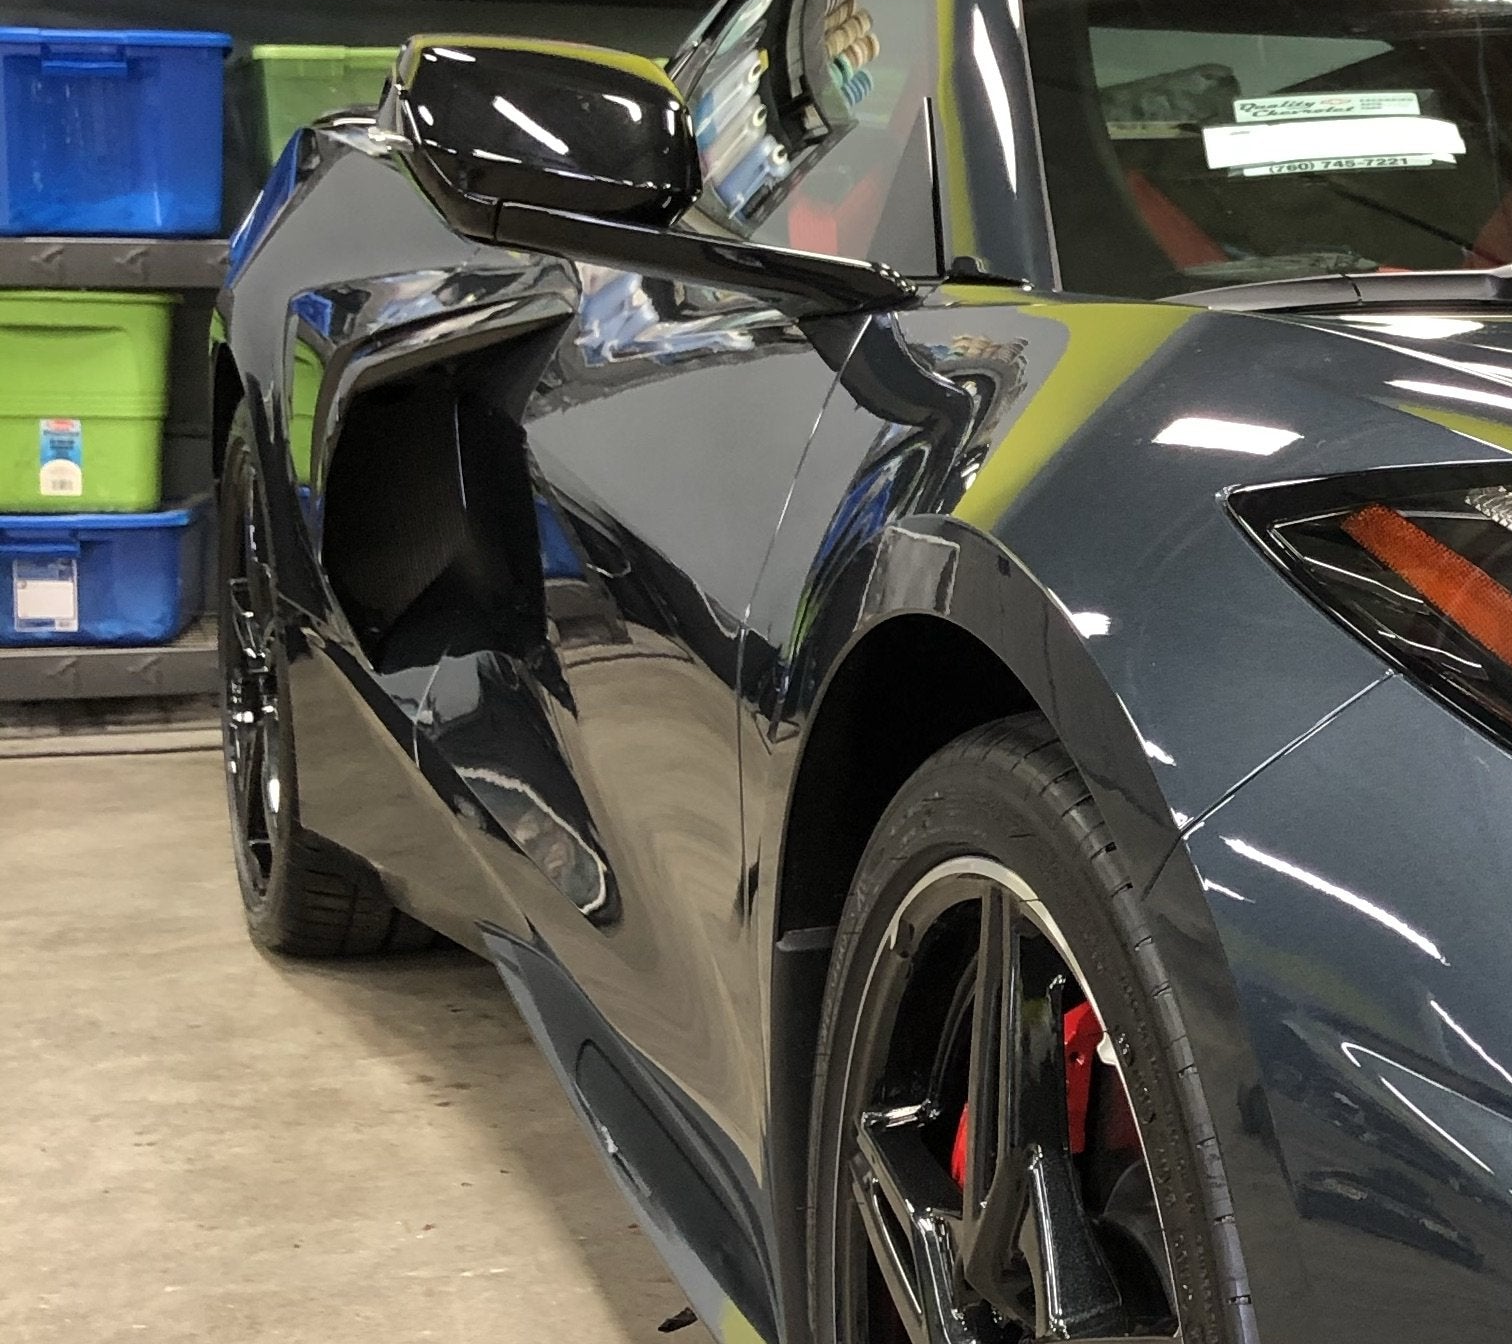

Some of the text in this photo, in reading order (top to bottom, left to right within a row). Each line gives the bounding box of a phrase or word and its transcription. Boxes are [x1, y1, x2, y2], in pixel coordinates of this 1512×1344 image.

[1239, 99, 1316, 113] Quality
[1252, 106, 1355, 118] Chevrolet
[1269, 160, 1315, 174] (760)
